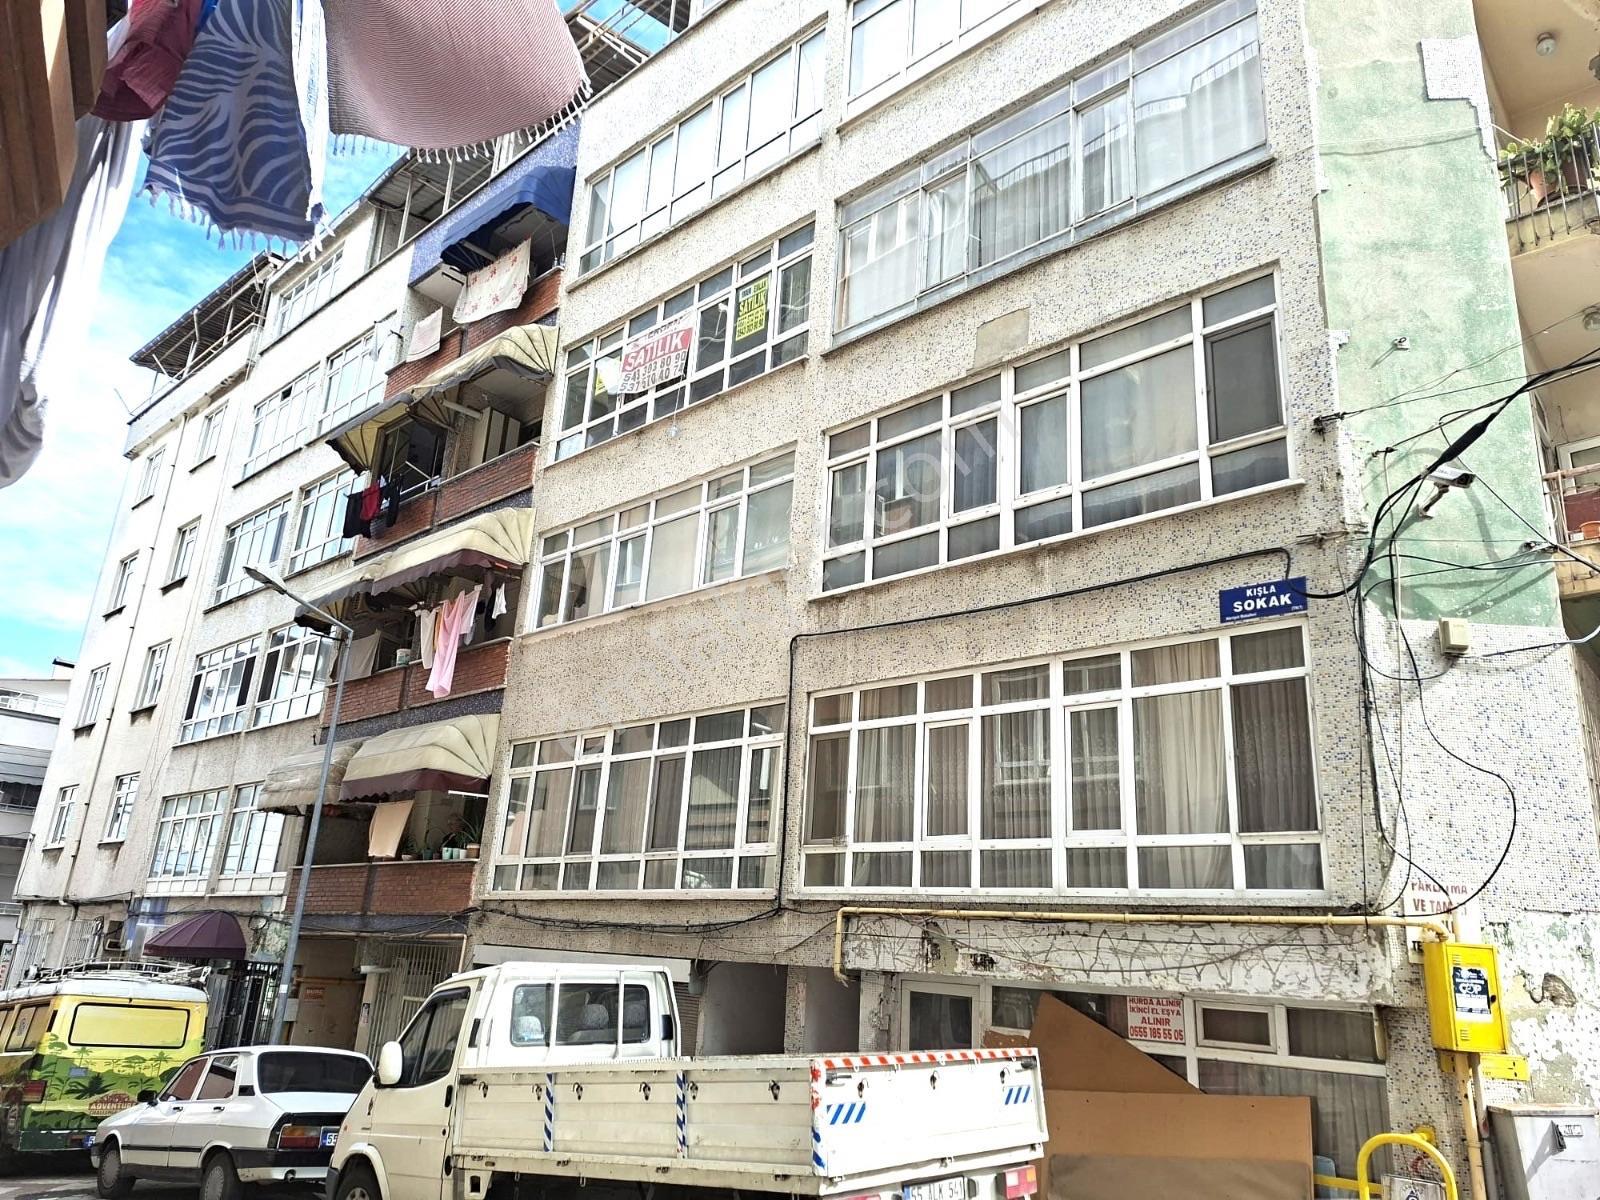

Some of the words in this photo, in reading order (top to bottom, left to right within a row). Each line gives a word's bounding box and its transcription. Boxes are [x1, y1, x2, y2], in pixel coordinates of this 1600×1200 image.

[739, 290, 767, 316] SATILIK
[624, 331, 685, 372] SATILIK
[660, 355, 671, 368] 80
[674, 350, 686, 363] 90
[619, 378, 640, 392] 537
[659, 367, 670, 381] 40
[1246, 585, 1276, 598] KIŞLA
[1233, 593, 1292, 612] SOKAK
[1413, 898, 1426, 912] VE
[1129, 997, 1154, 1006] HURDA
[1156, 999, 1181, 1008] ALINIR
[1130, 1005, 1150, 1014] İKİNCİ
[1141, 1017, 1171, 1026] ALINIR
[1130, 1026, 1147, 1037] 0555
[1150, 1028, 1161, 1038] 185
[1163, 1029, 1172, 1039] 55
[1174, 1030, 1183, 1041] 05
[911, 1184, 923, 1200] 55
